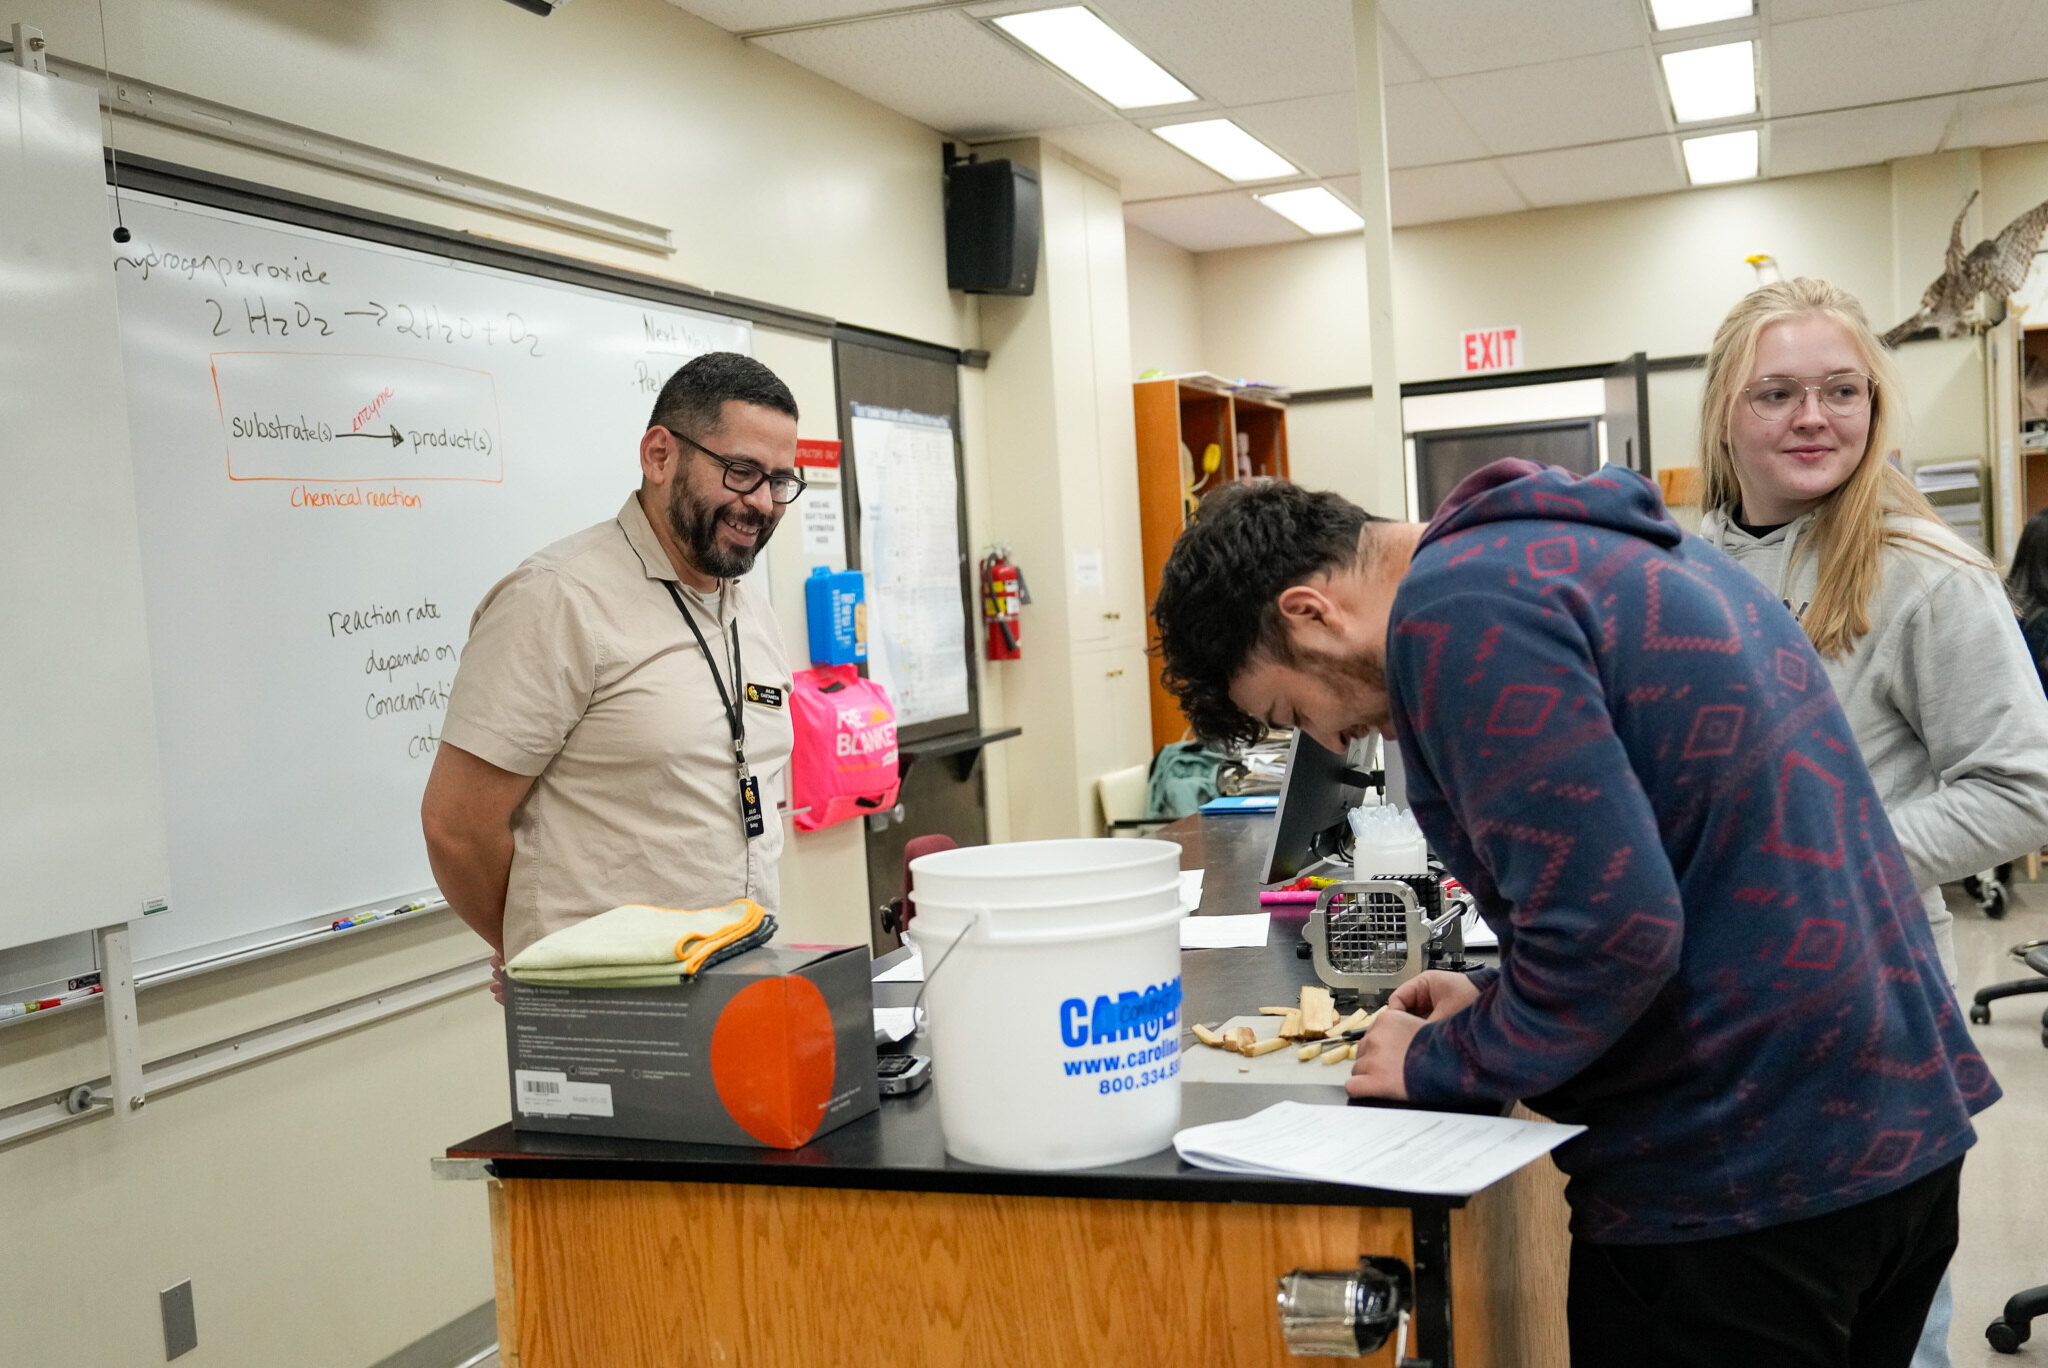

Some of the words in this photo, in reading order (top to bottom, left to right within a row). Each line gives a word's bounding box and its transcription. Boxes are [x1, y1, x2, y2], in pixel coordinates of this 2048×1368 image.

[642, 312, 678, 349] Next
[1465, 328, 1517, 370] EXIT
[352, 385, 395, 433] enzyme
[232, 411, 333, 442] substrate(s)
[408, 429, 493, 456] product(s)
[290, 485, 362, 508] Chemical
[366, 485, 423, 510] reaction
[328, 604, 401, 637] reaction
[407, 597, 440, 624] rate
[435, 644, 457, 662] on
